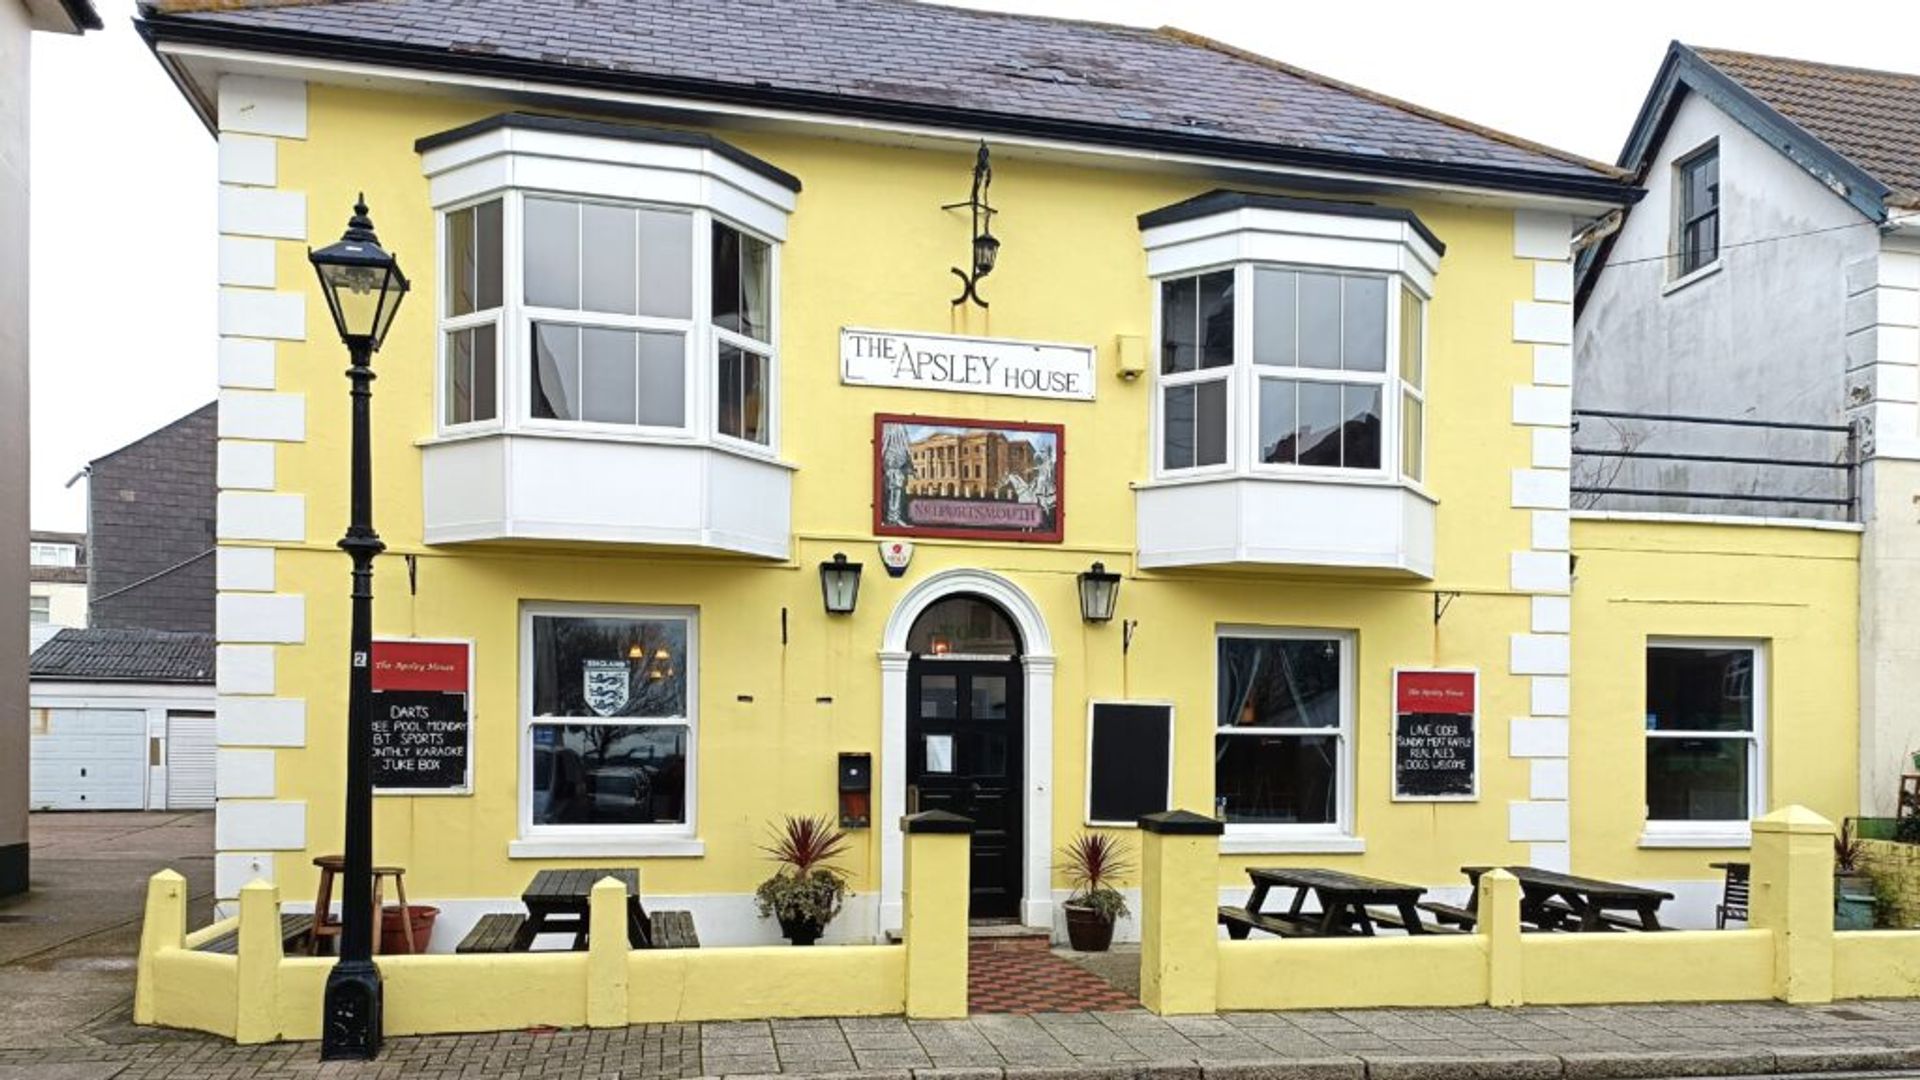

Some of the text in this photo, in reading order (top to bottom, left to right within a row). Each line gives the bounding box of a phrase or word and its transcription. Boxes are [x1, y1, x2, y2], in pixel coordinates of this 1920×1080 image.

[849, 335, 1080, 393] THE APSLEY HOUSE
[356, 654, 363, 665] 2
[376, 661, 392, 670] The
[390, 705, 430, 720] DARTS
[394, 721, 422, 732] POOL
[1435, 725, 1459, 737] CIDER
[373, 733, 444, 746] BT SPORTS
[372, 746, 464, 758] ONTHLY KARAOKE
[383, 759, 441, 771] JUKE BOX
[1406, 760, 1430, 770] DOGS
